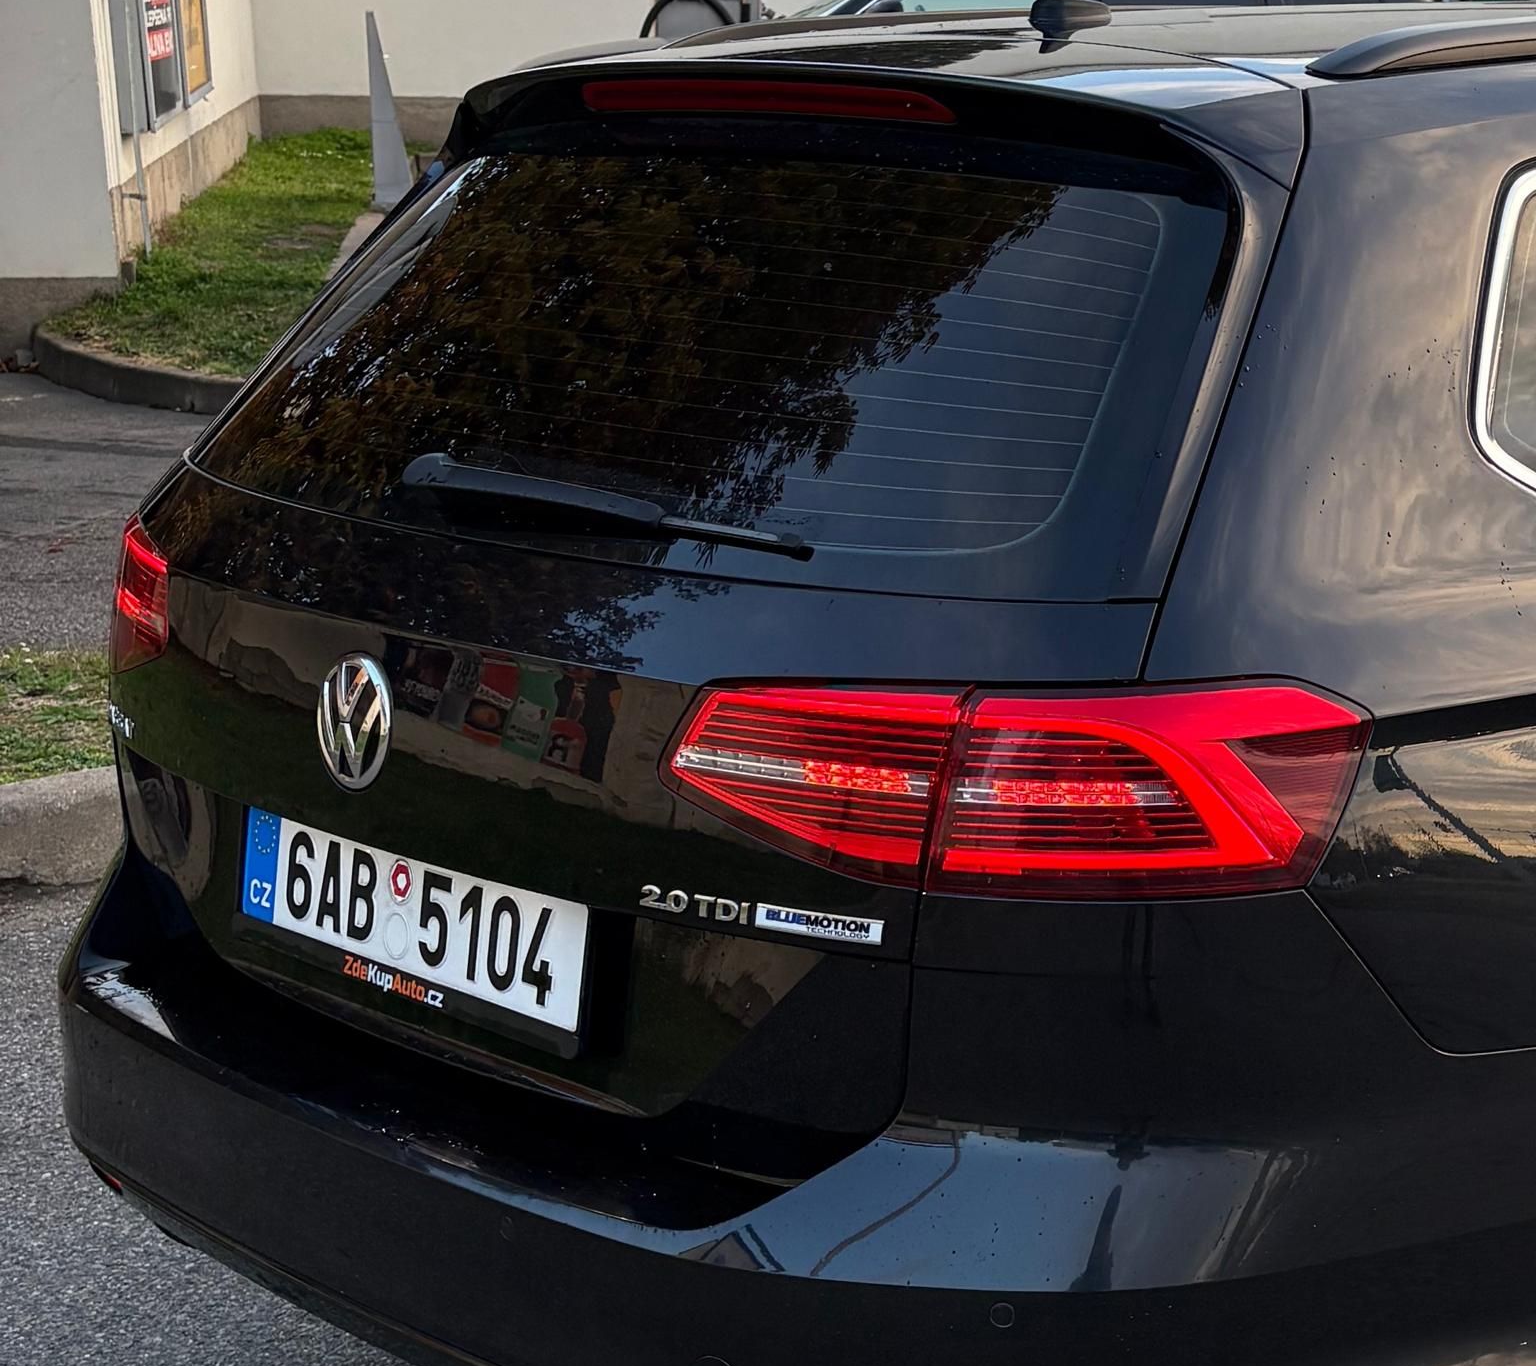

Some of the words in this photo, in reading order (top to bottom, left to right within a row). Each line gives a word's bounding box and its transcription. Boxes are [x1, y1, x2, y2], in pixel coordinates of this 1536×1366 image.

[249, 878, 272, 908] CZ
[285, 830, 378, 942] 6AB
[418, 869, 555, 1008] 5104
[694, 893, 751, 925] TDI
[765, 908, 871, 935] BLUEMOTION
[805, 925, 870, 940] TECHNOLOGY
[343, 954, 444, 1009] ZdeKupAuto.cz
